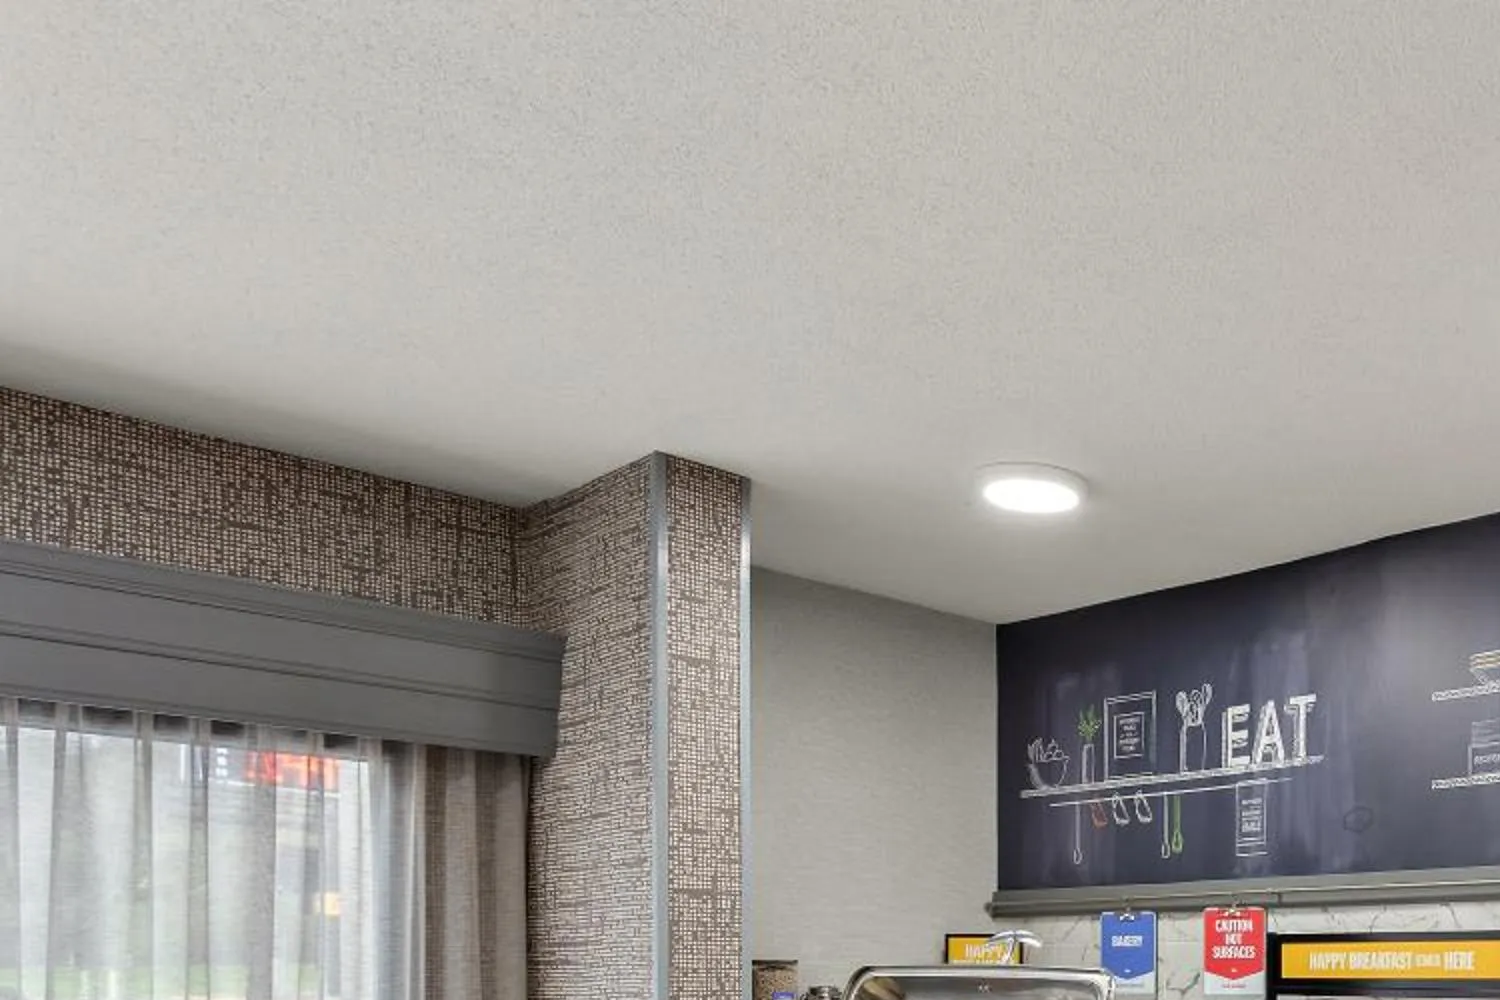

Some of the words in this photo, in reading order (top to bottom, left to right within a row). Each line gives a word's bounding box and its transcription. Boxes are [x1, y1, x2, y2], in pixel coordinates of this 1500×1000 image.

[1221, 694, 1317, 768] EAT
[1215, 919, 1253, 933] CAUTION
[1225, 933, 1242, 945] HOT
[1212, 945, 1256, 959] SURFACES
[1309, 951, 1346, 970] HAPPY
[1349, 950, 1412, 970] BREAKFAST
[1444, 951, 1475, 970] HERE
